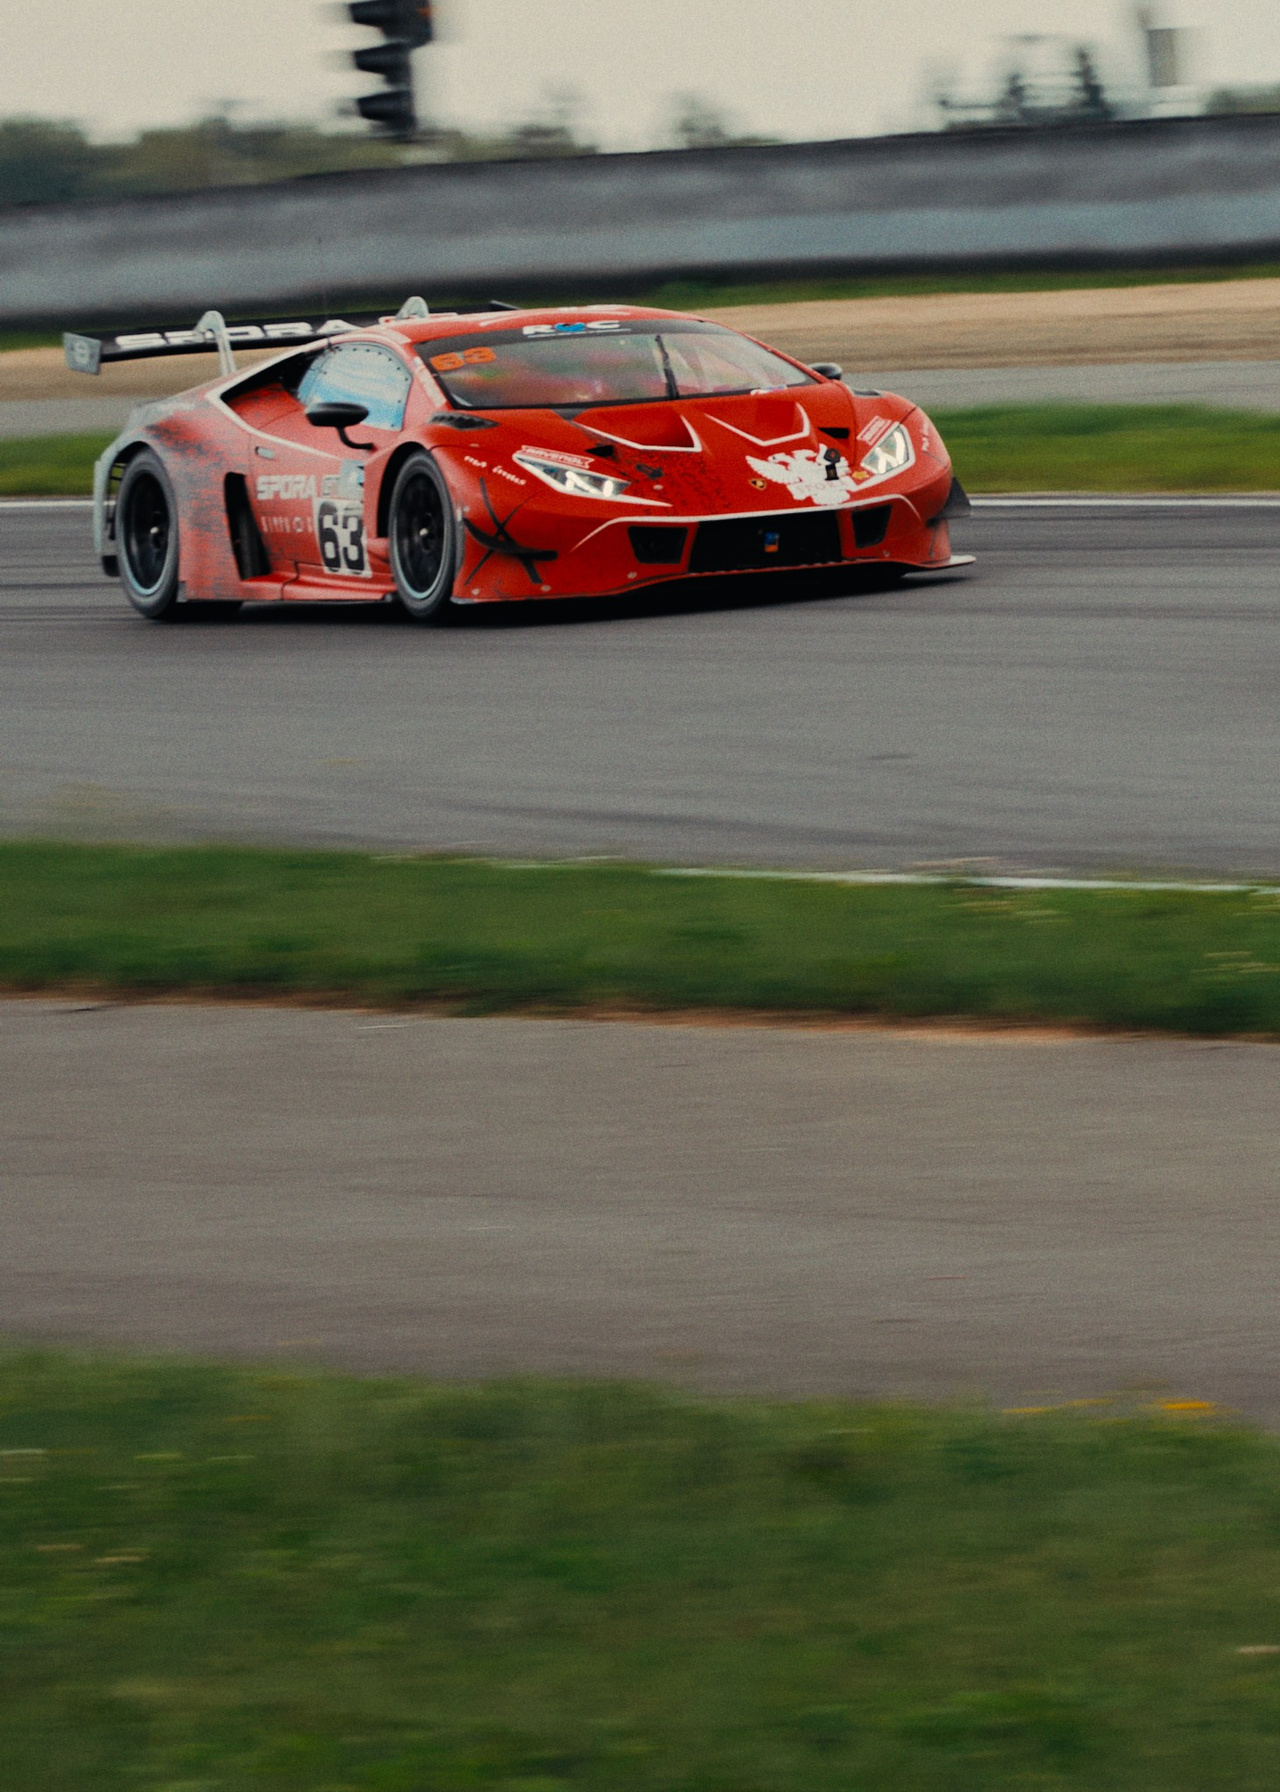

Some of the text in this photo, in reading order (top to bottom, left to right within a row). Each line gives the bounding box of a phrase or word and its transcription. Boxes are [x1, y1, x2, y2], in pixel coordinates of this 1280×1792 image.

[430, 347, 496, 371] 63
[256, 473, 316, 500] SPORA
[318, 501, 365, 572] 63
